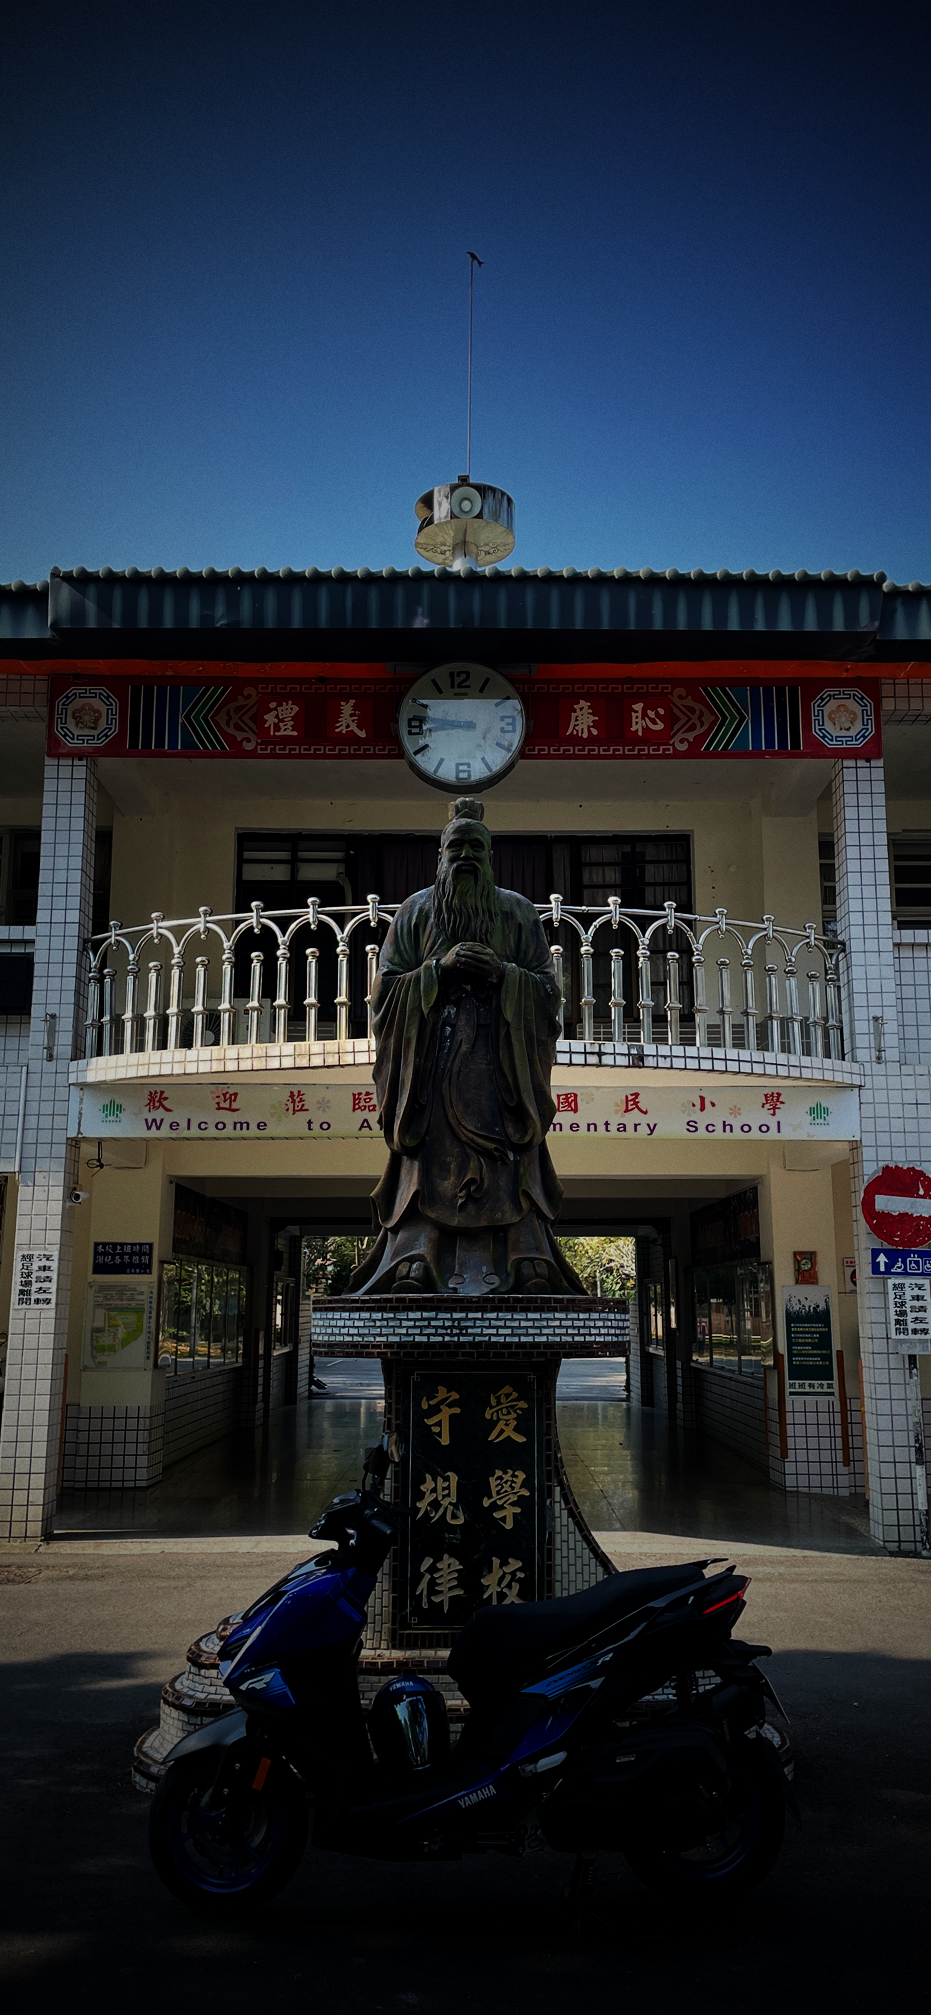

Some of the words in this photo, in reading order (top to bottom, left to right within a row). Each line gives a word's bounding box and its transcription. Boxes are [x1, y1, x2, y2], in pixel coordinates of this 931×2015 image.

[448, 670, 471, 689] 12
[407, 717, 423, 736] 9
[499, 715, 517, 734] 3
[455, 762, 471, 781] 6
[556, 1091, 786, 1117] 國民小學
[144, 1118, 268, 1132] Welcome
[306, 1118, 332, 1132] to
[685, 1119, 782, 1134] School
[17, 1253, 35, 1306] 經足球場離開
[33, 1253, 55, 1306] 汽車請左轉
[892, 1282, 909, 1336] 經足球場離開
[908, 1282, 930, 1336] 汽車請左轉
[788, 1382, 835, 1390] 班班有冷氣
[415, 1385, 465, 1615] 守規律
[480, 1384, 531, 1606] 愛學校
[457, 1784, 497, 1809] YAMAHA
